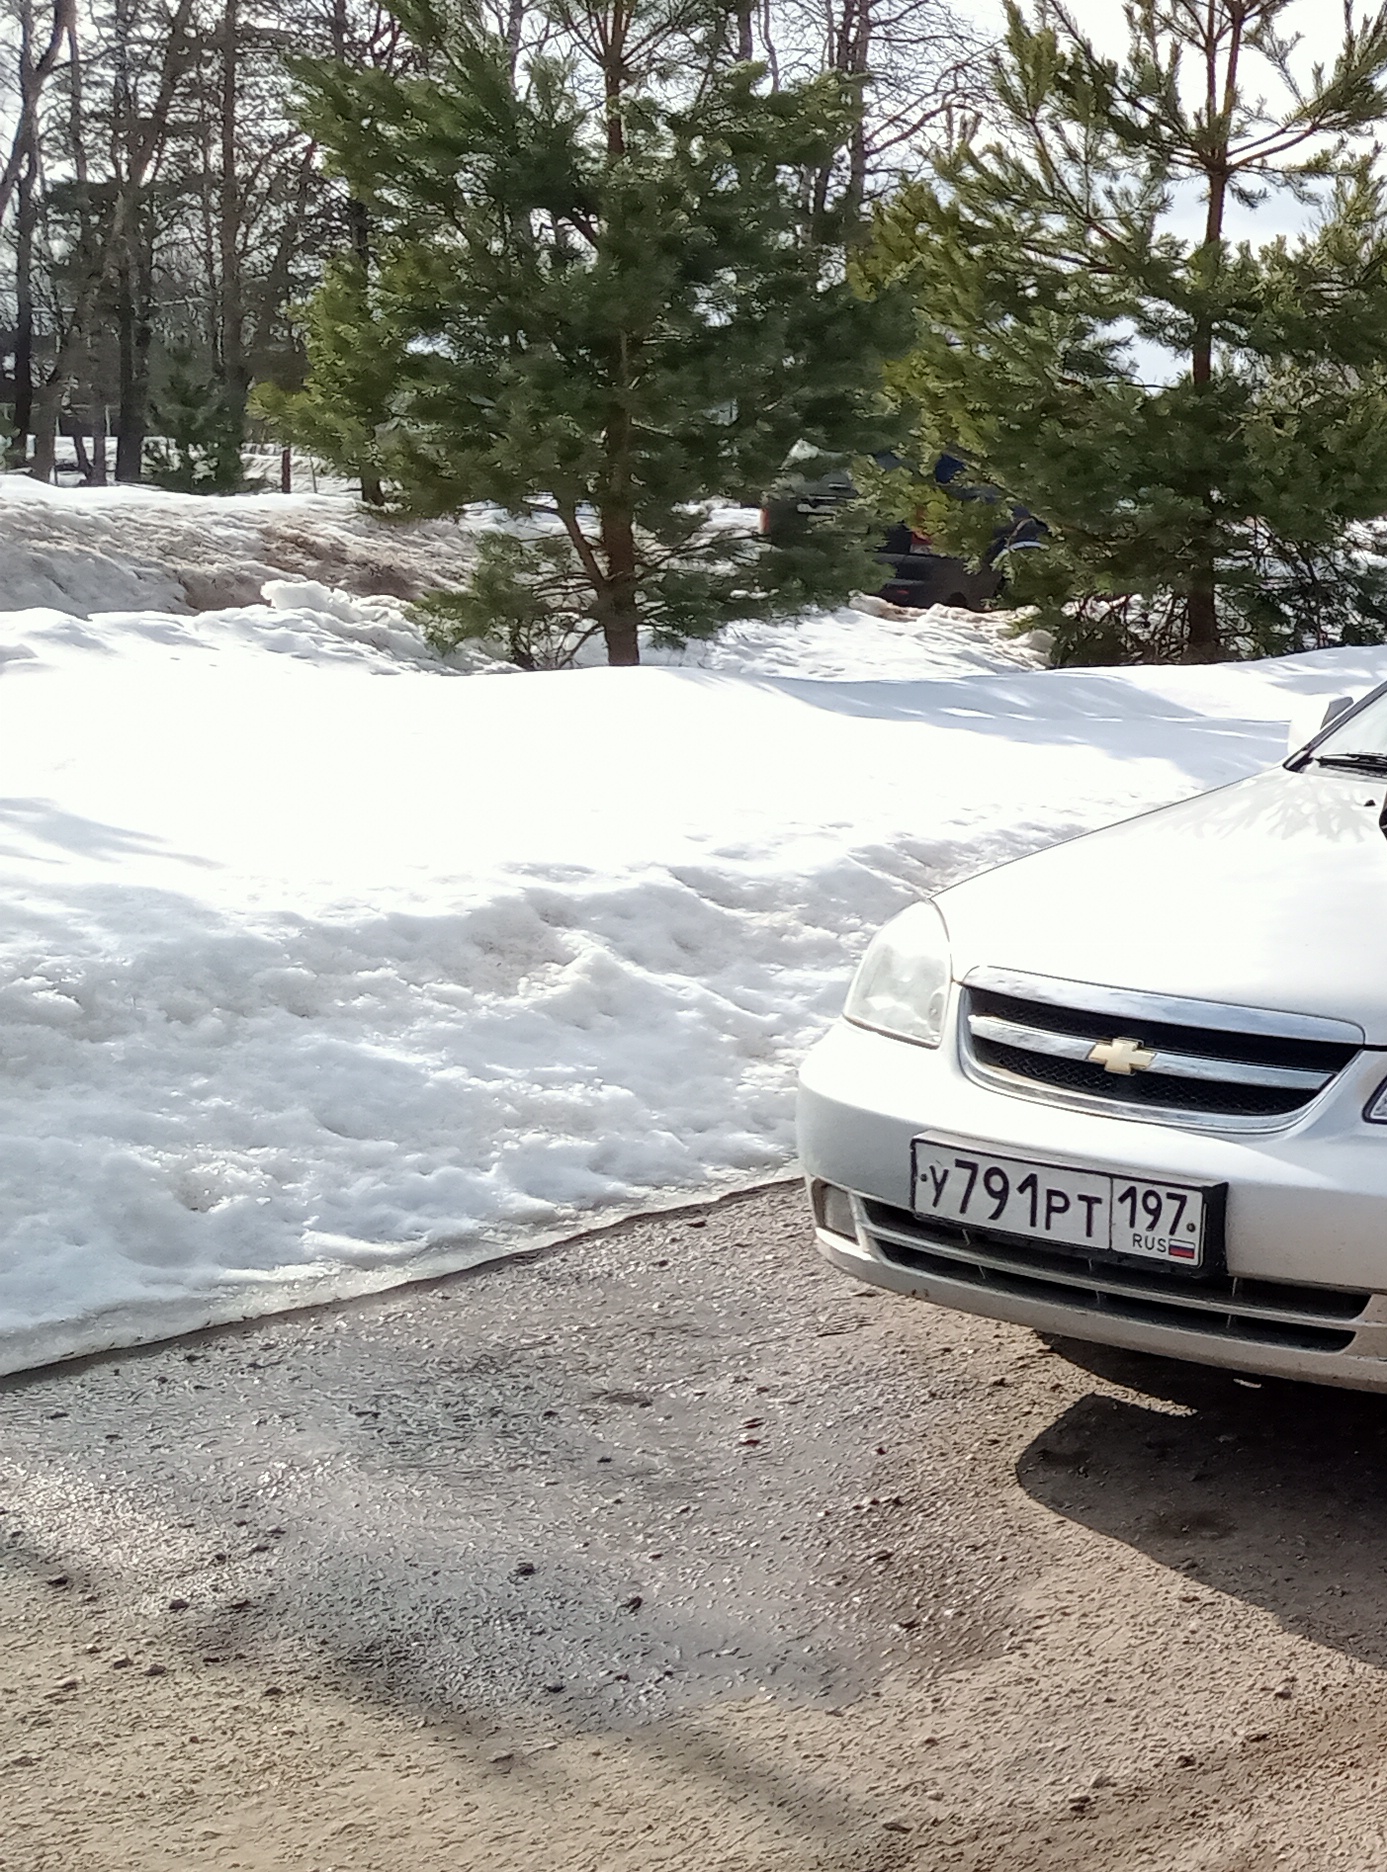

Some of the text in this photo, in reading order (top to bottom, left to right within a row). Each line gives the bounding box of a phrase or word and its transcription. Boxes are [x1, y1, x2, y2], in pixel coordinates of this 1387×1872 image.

[929, 1158, 1103, 1238] У791РТ
[1117, 1186, 1188, 1236] 197
[1132, 1233, 1167, 1252] RUS
